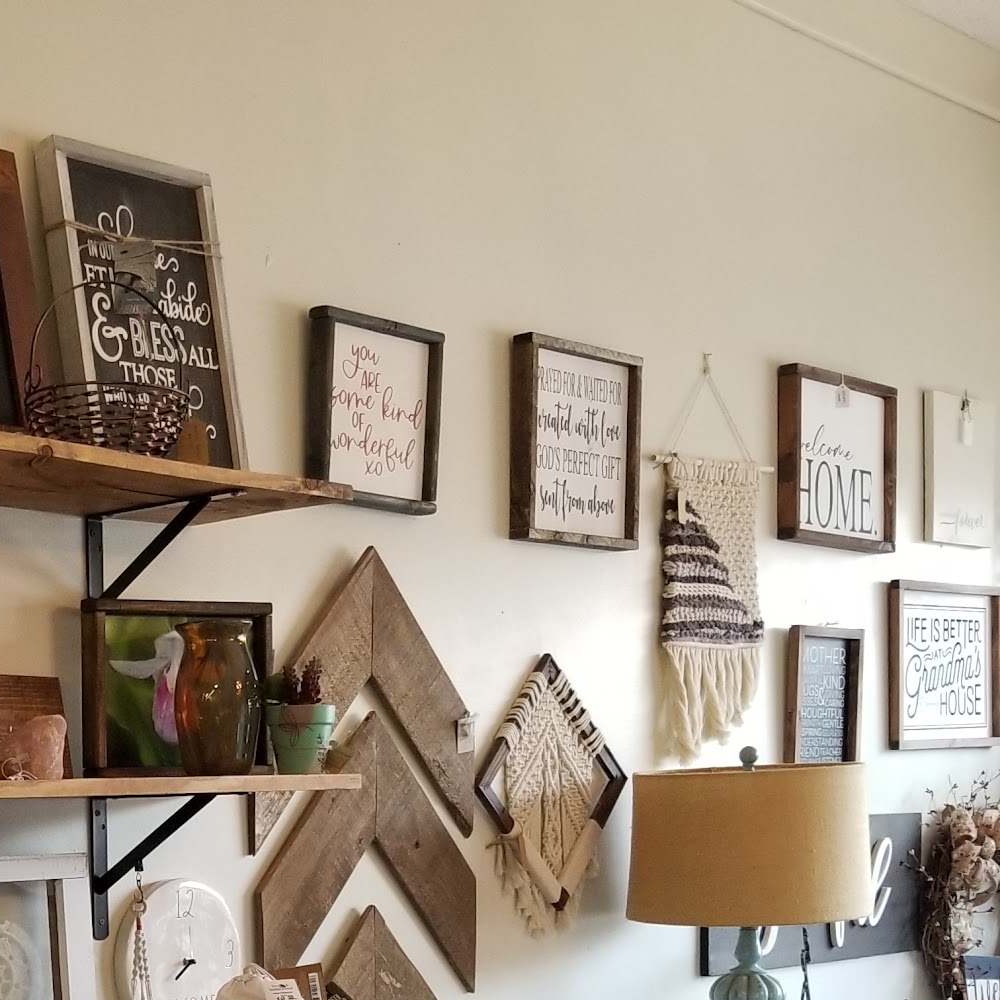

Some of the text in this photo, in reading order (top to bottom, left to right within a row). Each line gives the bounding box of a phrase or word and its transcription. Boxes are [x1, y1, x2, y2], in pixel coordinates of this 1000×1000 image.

[157, 277, 212, 327] abide
[128, 317, 219, 370] BLESS ALL
[118, 360, 179, 391] THOSE
[342, 343, 381, 380] you
[359, 370, 383, 395] ARE
[537, 365, 562, 395] PRAYED
[563, 372, 577, 398] FOR
[582, 375, 609, 404] WAITED
[608, 381, 623, 407] FOR
[329, 385, 425, 430] some kind
[351, 411, 367, 433] OF
[537, 400, 622, 449] created with love
[329, 424, 417, 473] wonderful
[536, 443, 622, 482] GOD'S PERFECT GIFT
[364, 460, 384, 477] xo
[538, 478, 616, 523] sent from above
[905, 617, 982, 652] LIFE IS BETTER
[802, 684, 819, 697] UGS
[822, 675, 847, 691] KIND
[905, 641, 982, 719] Grandma's
[800, 707, 845, 719] HOUGHTFUL
[940, 683, 982, 716] HOUSE
[800, 737, 844, 747] NDERSTANDING
[800, 746, 820, 758] RIEND
[174, 889, 196, 919] 12
[224, 939, 236, 969] 3
